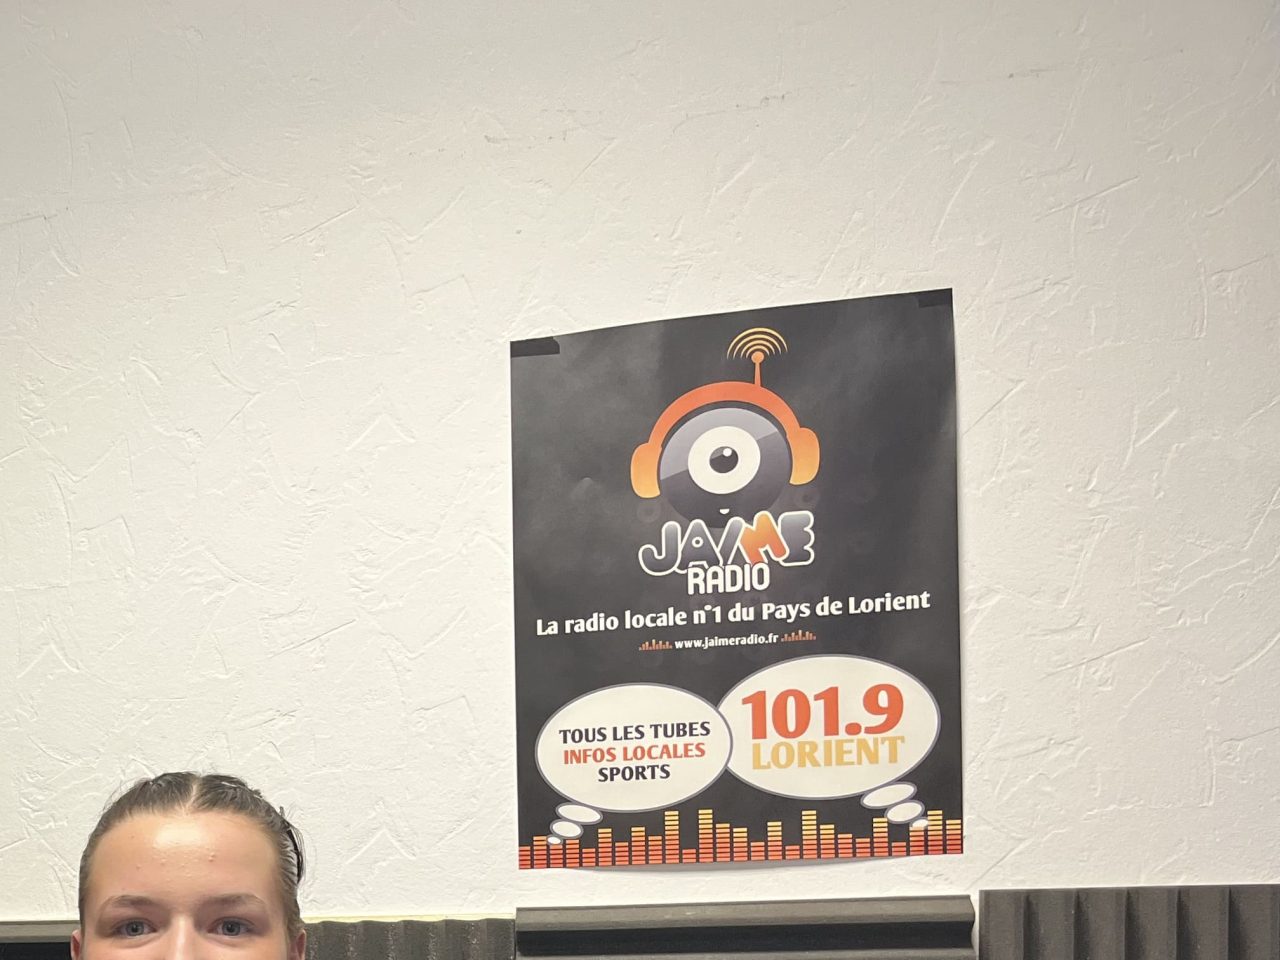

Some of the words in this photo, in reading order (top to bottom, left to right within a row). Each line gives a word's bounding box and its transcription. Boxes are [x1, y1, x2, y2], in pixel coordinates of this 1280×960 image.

[687, 562, 771, 595] RADIO
[536, 617, 559, 636] La
[565, 611, 619, 634] radio
[625, 606, 688, 630] locale
[728, 602, 754, 622] du
[762, 601, 811, 624] Pays
[816, 597, 843, 616] de
[849, 590, 931, 614] Lorient
[674, 633, 779, 650] www.jaimeradio.fr
[741, 683, 905, 740] 101.9
[559, 726, 607, 744] TOUS
[612, 724, 645, 741] LES
[649, 721, 711, 739] TUBES
[563, 746, 617, 765] INFOS
[622, 742, 706, 762] LOCALES
[752, 735, 905, 771] LORIENT
[598, 763, 671, 782] SPORTS
